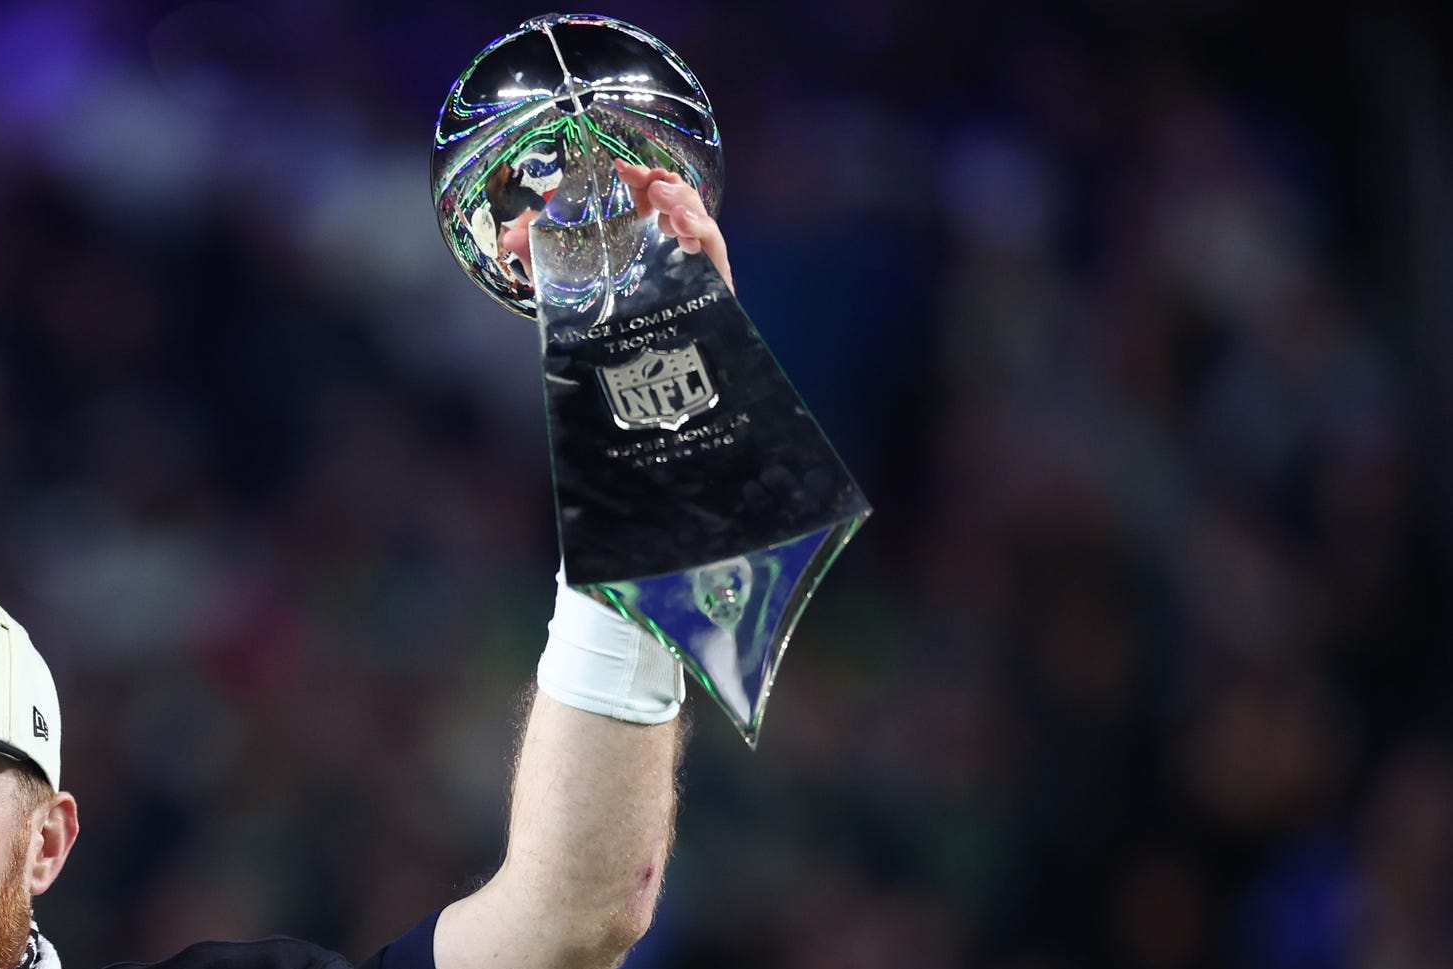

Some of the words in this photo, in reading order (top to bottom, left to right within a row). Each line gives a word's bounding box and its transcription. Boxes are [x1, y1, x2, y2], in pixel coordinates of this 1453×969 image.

[552, 325, 612, 344] VINCE
[618, 292, 718, 334] LOMBARDI
[604, 325, 679, 354] TROPHY
[621, 370, 705, 418] NFL
